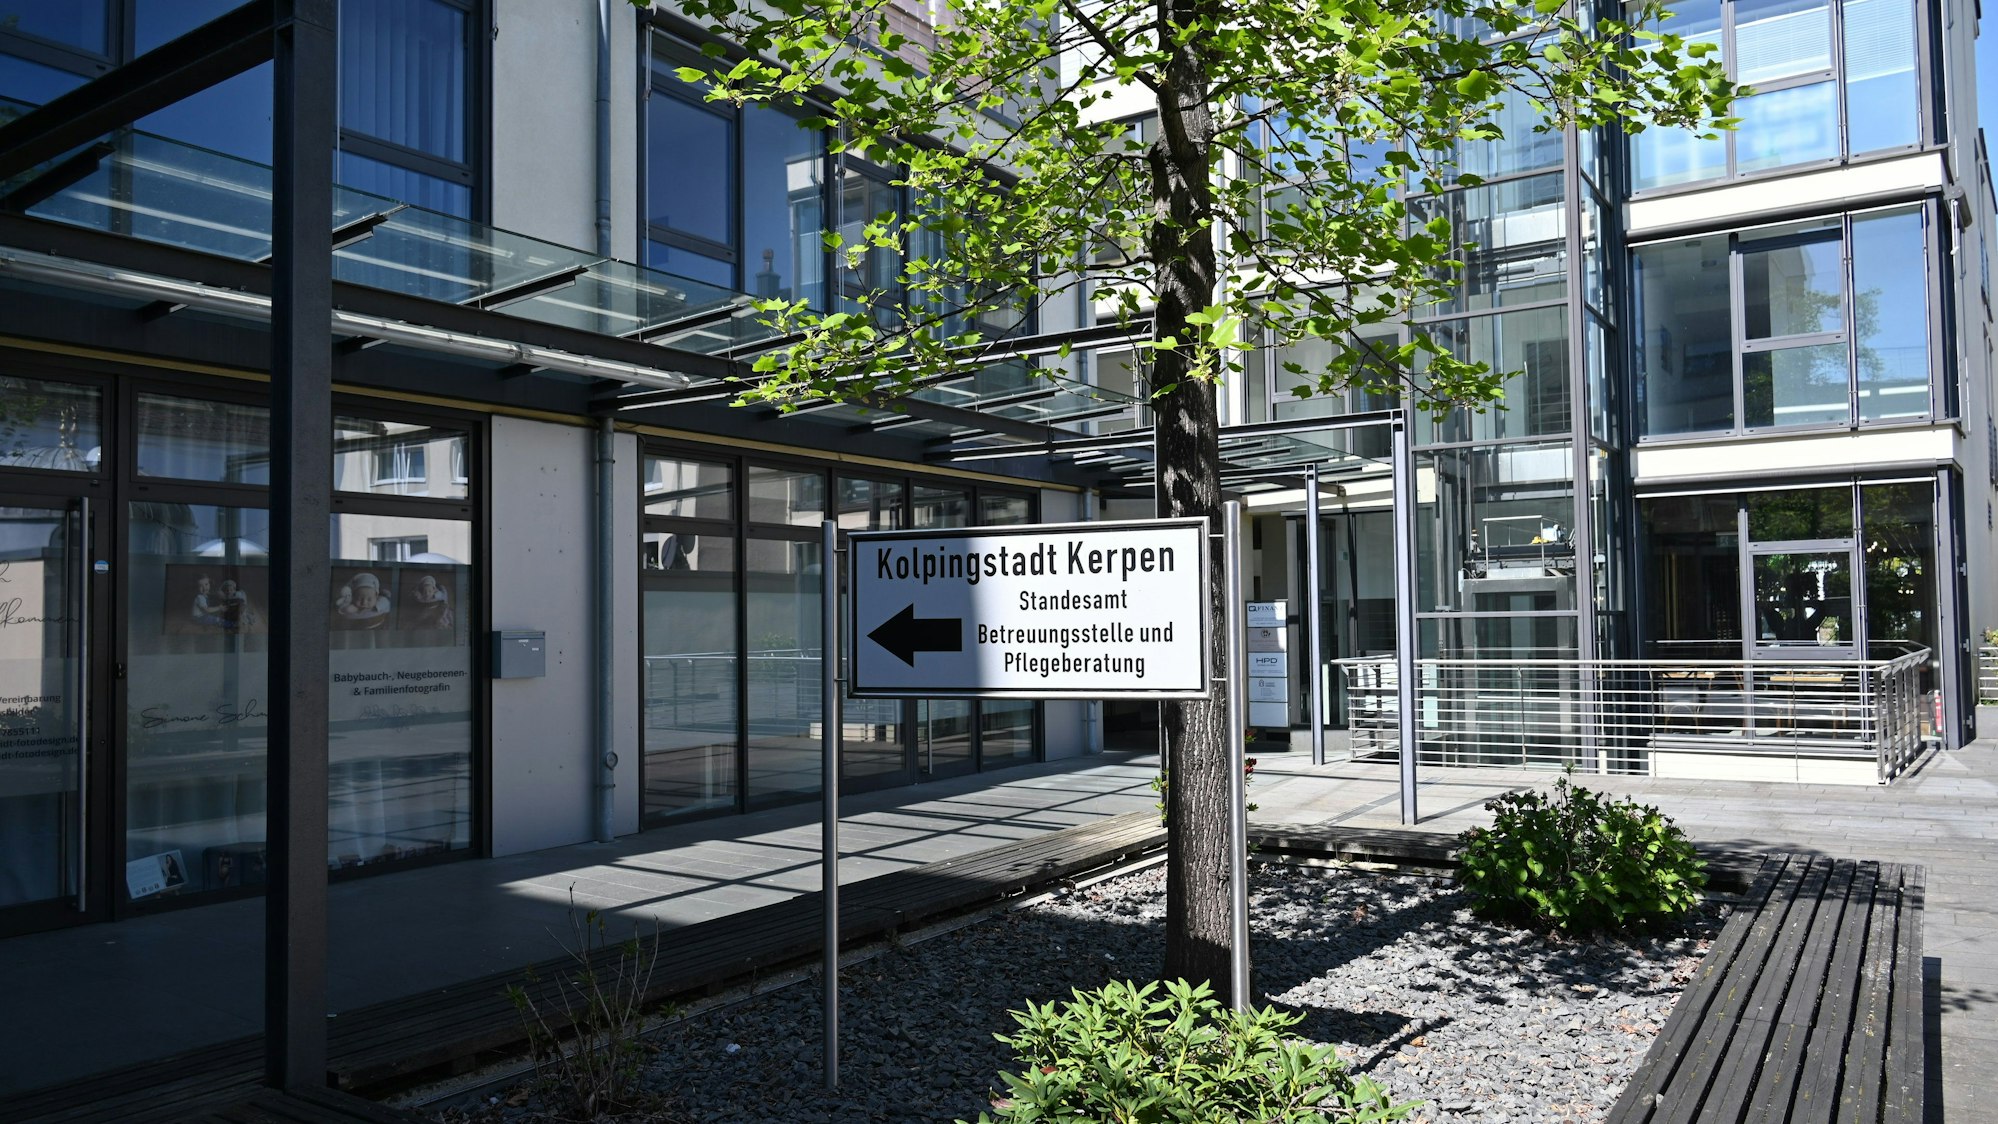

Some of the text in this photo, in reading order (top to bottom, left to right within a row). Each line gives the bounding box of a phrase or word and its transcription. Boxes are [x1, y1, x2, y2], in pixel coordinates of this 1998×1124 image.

[877, 541, 1175, 585] Kolpingstadt Kerpen
[1019, 589, 1128, 611] Standesamt
[978, 621, 1174, 649] Betreuungsstelle und
[1004, 652, 1146, 678] Pflegeberatung
[334, 669, 468, 684] Babybauch-, Neugeborenen-
[353, 683, 450, 696] & Familienfotografin
[141, 707, 209, 729] Simone
